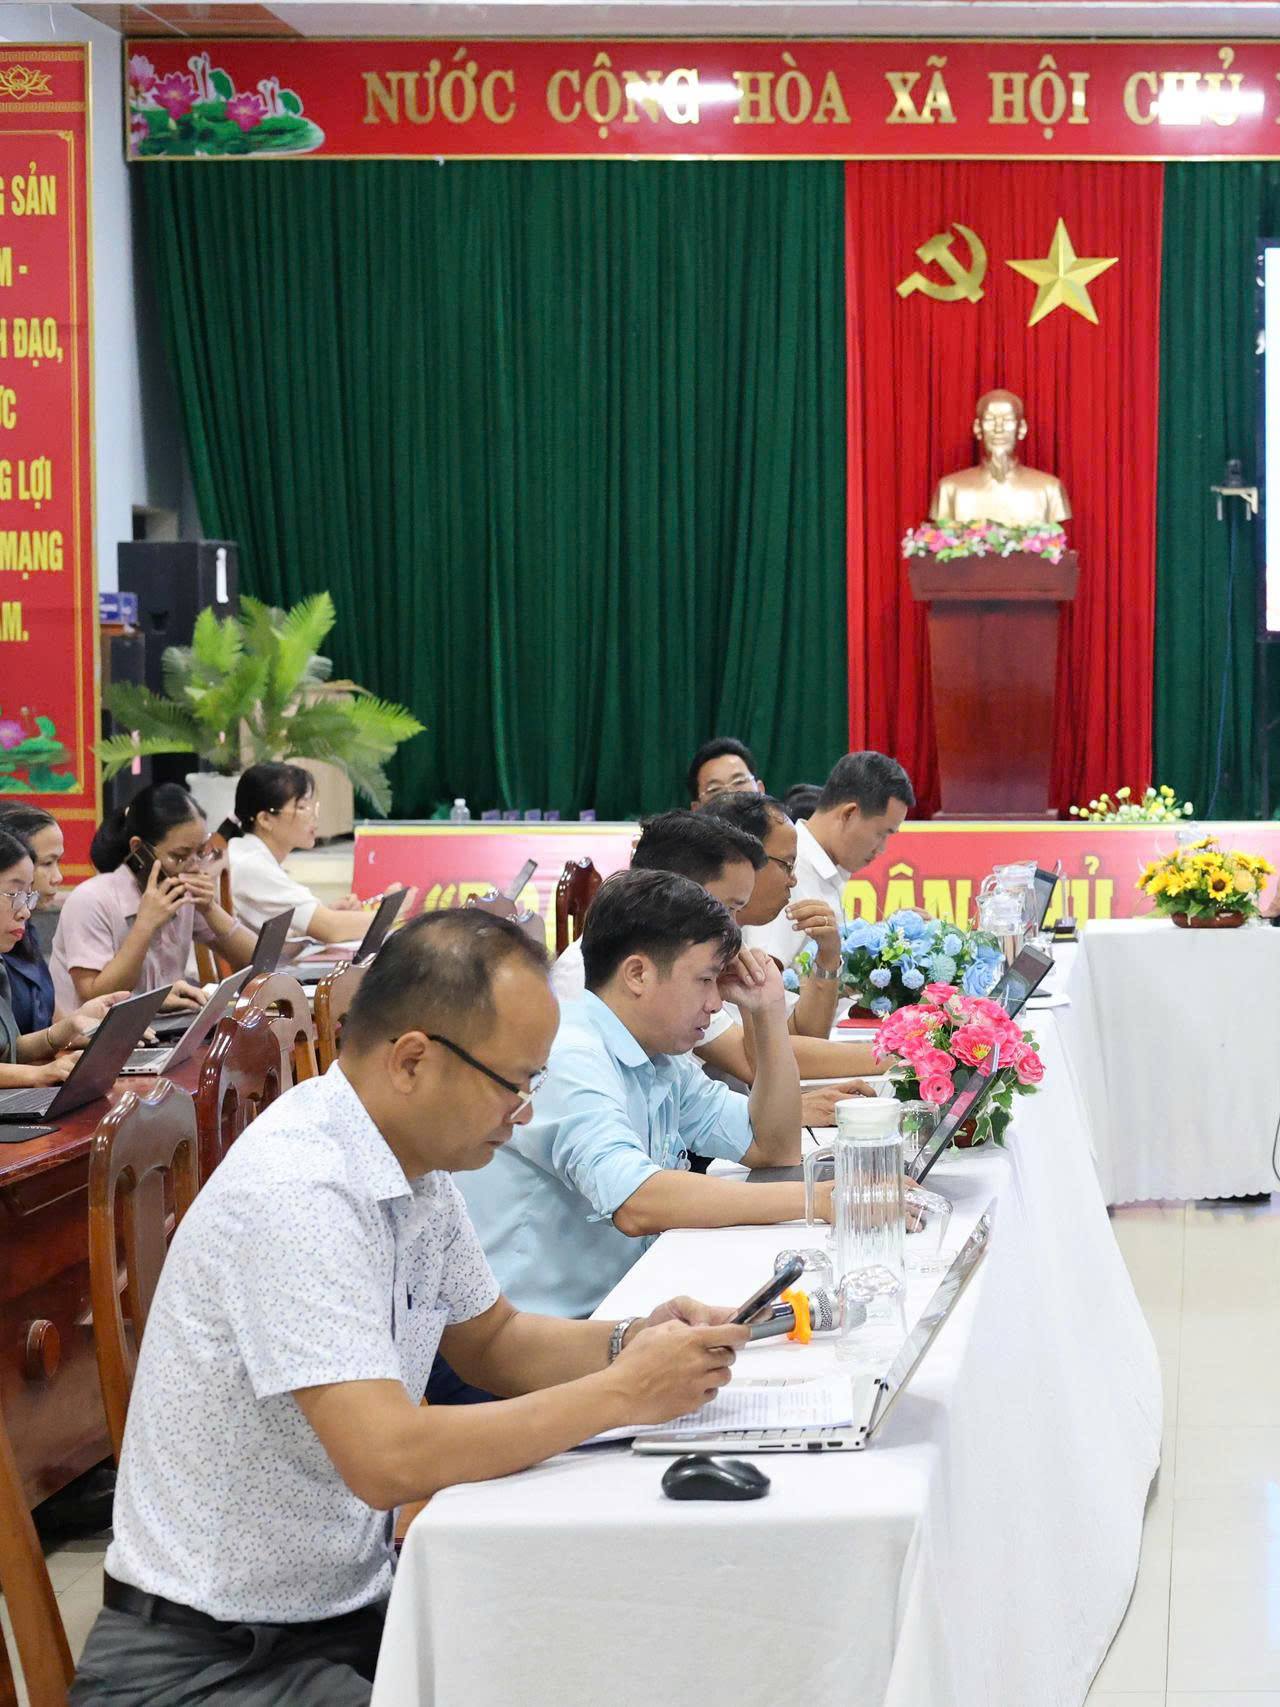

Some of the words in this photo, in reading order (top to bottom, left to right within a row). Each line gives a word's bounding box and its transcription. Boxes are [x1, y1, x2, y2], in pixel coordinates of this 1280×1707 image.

[363, 48, 515, 125] NƯỚC
[547, 52, 700, 138] CỘNG
[735, 52, 851, 125] HÒA
[886, 55, 957, 124] XÃ
[988, 54, 1089, 139] HỘI
[1124, 47, 1246, 127] CHỦ
[11, 162, 57, 216] SẢN
[13, 317, 64, 367] ĐẠO,
[18, 455, 52, 510] LỢI
[843, 863, 972, 932] DÂN
